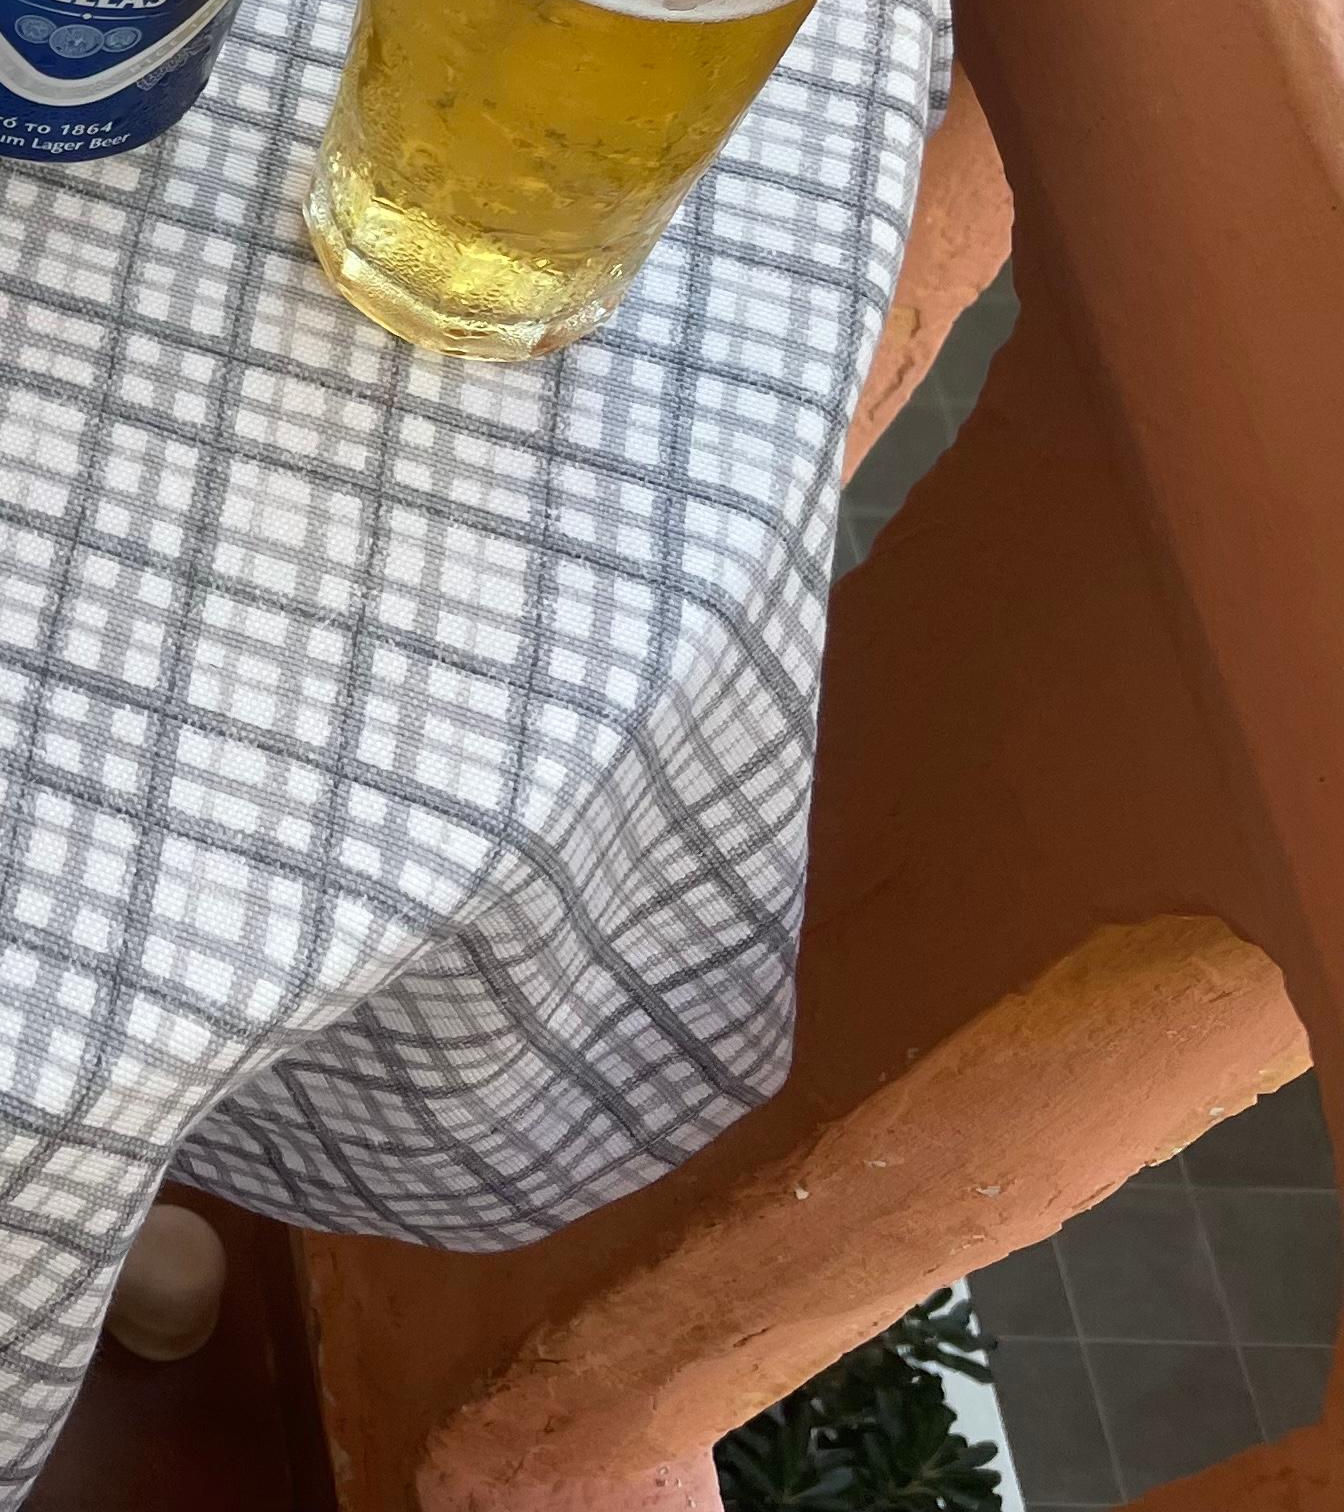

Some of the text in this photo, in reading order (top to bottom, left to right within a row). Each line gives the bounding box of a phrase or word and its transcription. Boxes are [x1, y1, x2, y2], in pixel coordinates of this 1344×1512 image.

[24, 122, 52, 135] το
[60, 120, 113, 136] 1864
[31, 137, 84, 154] Lager
[88, 132, 131, 150] Beer
